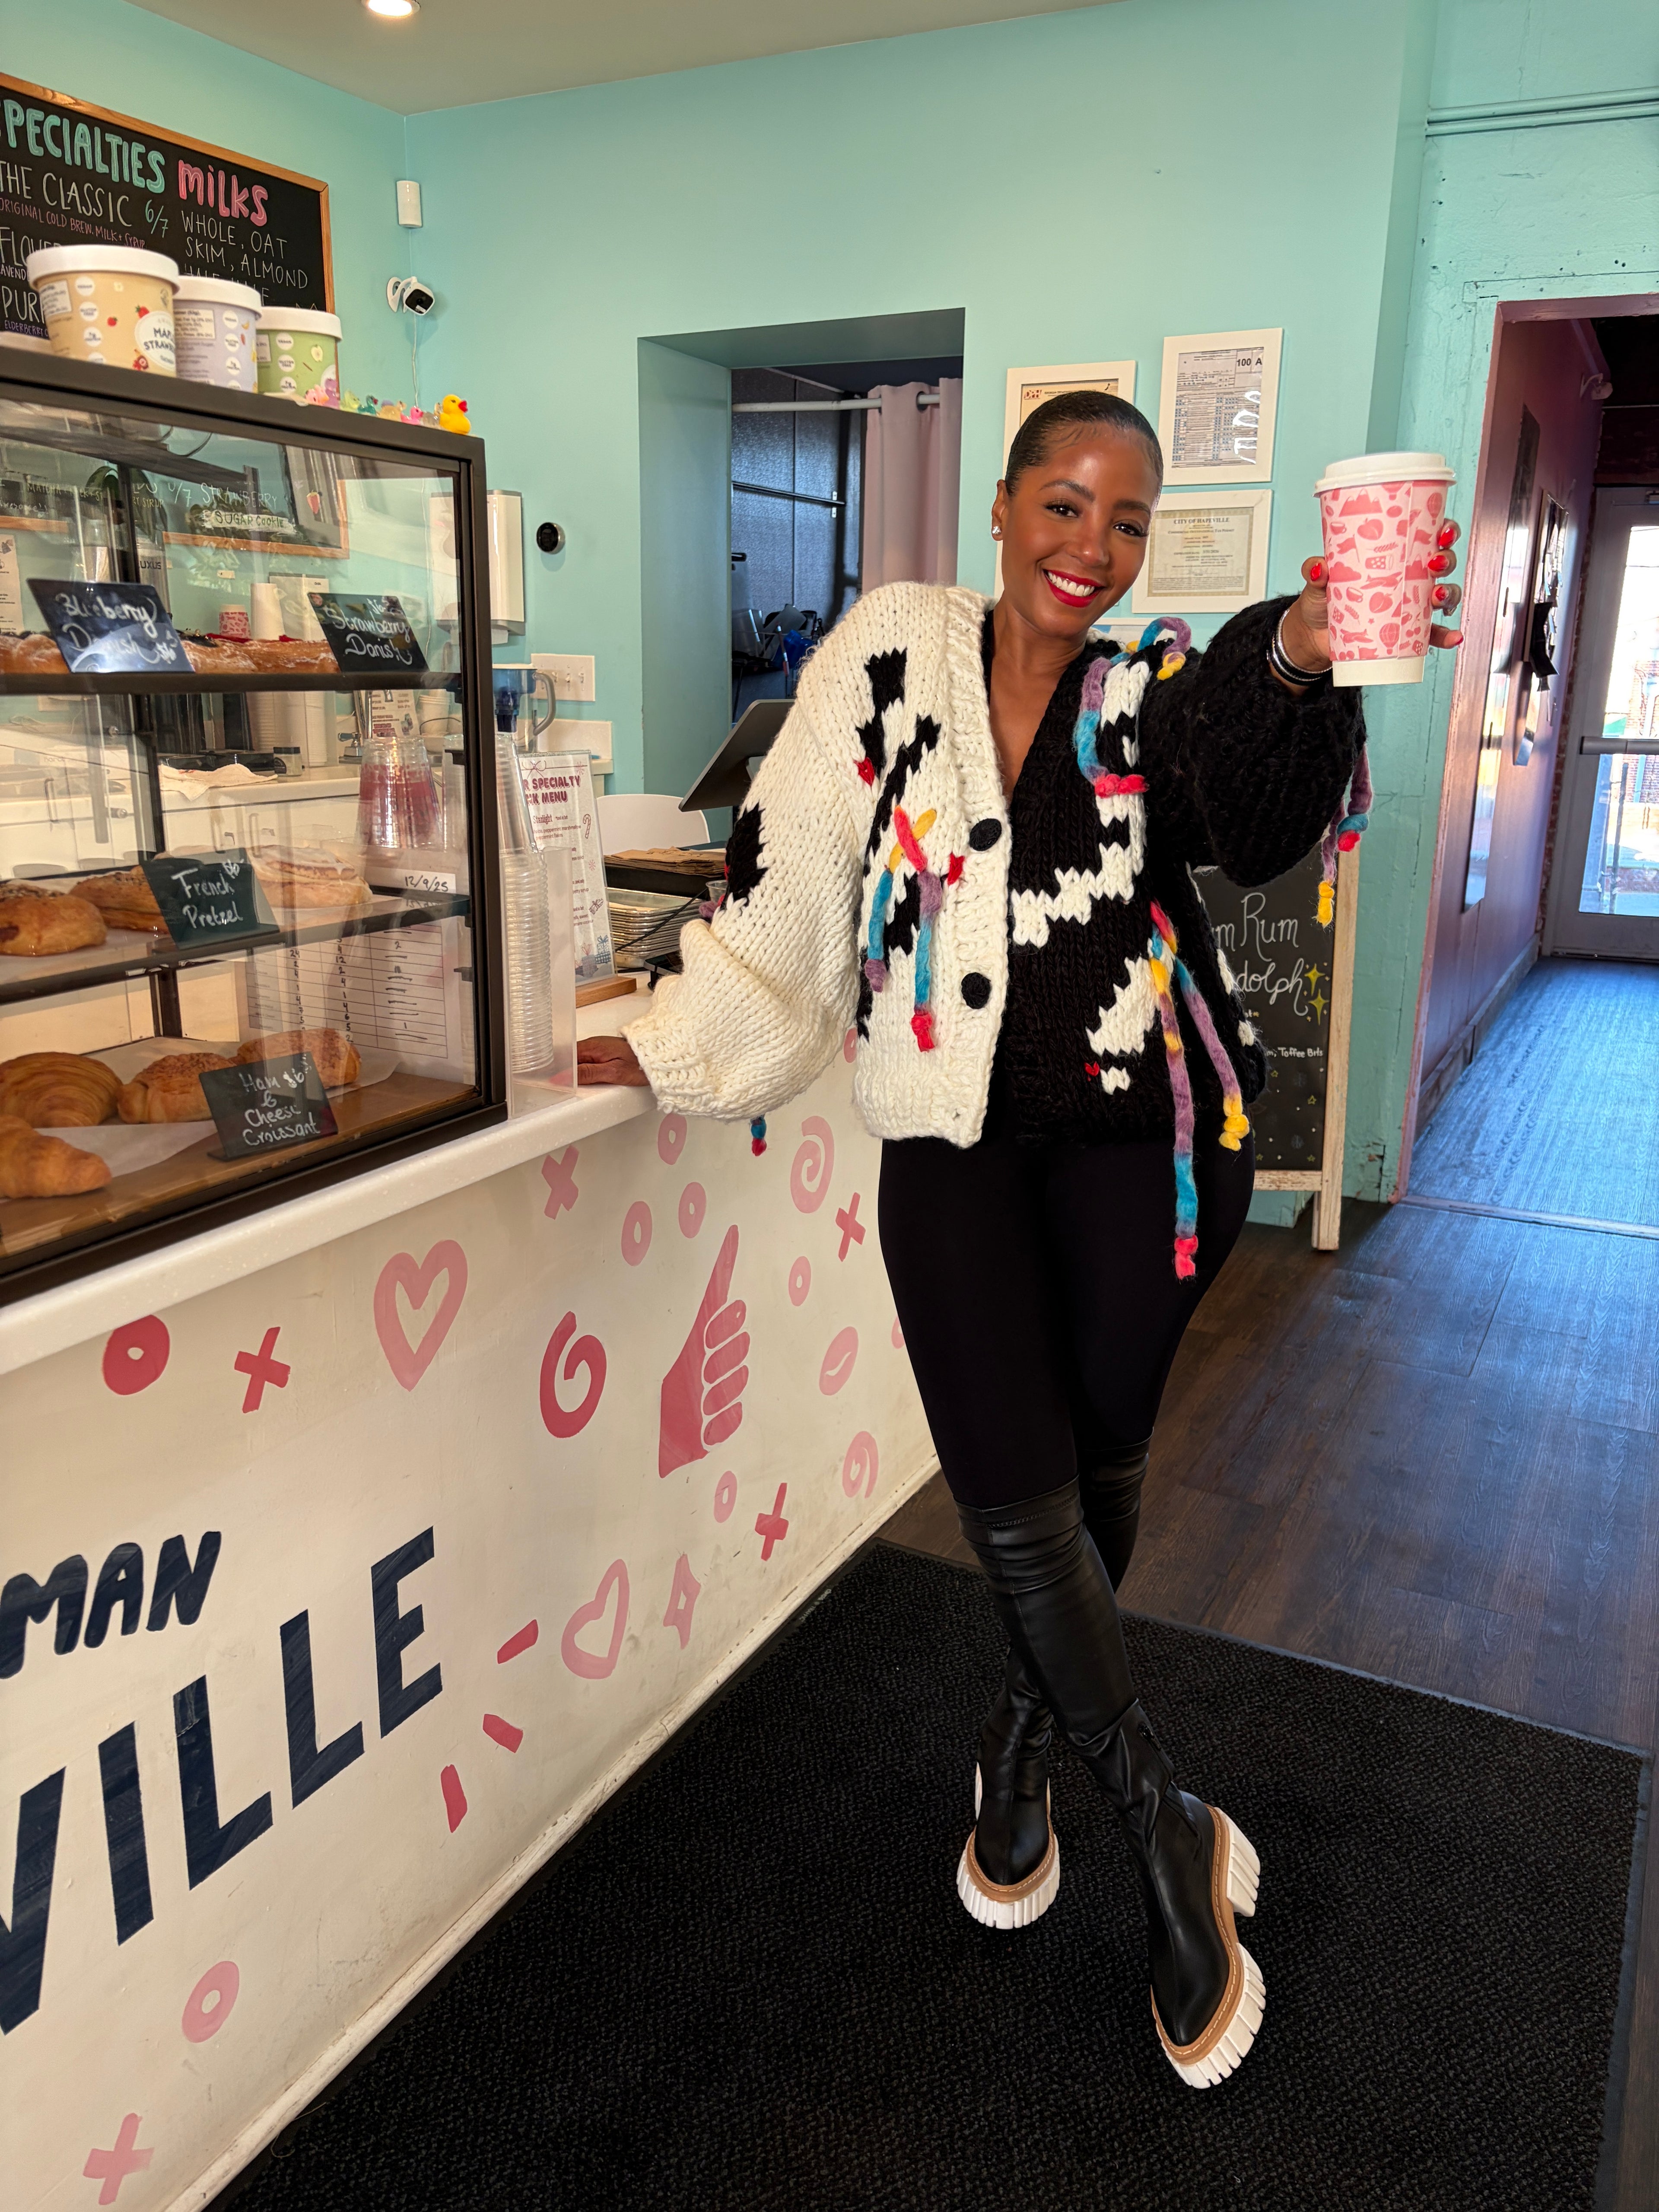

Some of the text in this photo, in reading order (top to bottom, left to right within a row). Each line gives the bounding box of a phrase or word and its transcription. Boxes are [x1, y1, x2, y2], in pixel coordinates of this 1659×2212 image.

[0, 99, 165, 194] PECIALTIES
[0, 160, 169, 238] THE CLASSIC 6/7
[0, 197, 44, 223] ORIGINAL
[46, 211, 67, 227] COLD
[95, 225, 118, 241] MILK
[0, 226, 62, 267] FLO
[251, 231, 288, 259] OAT
[0, 263, 30, 281] AVEND
[241, 254, 308, 289] ALMOND
[1, 285, 45, 324] PUR
[143, 340, 175, 353] STRAW
[1237, 358, 1252, 366] 100
[0, 501, 49, 515] wesoe!!
[200, 482, 277, 512] STRAWBERRY
[216, 511, 254, 526] SUGAR
[140, 560, 162, 570] UXUS
[323, 605, 410, 643] Strawberry
[62, 623, 161, 664] Dish
[345, 633, 413, 665] Danish
[532, 775, 581, 791] SPECIALTY
[542, 791, 569, 804] MENU
[532, 814, 553, 825] Starlight
[171, 868, 235, 899] French
[405, 875, 448, 892] 12/9/25
[182, 901, 244, 929] Pretzel
[1240, 892, 1299, 962] Rum
[394, 941, 401, 950] 2
[341, 978, 346, 987] 4
[1236, 957, 1308, 1016] dolph
[343, 1002, 349, 1012] 4
[346, 1023, 351, 1031] 5
[1278, 1047, 1306, 1058] Toffee
[1307, 1046, 1323, 1057] Bits
[239, 1072, 281, 1092] Ham
[242, 1112, 321, 1146] Croissant
[0, 1531, 221, 1679] MAN
